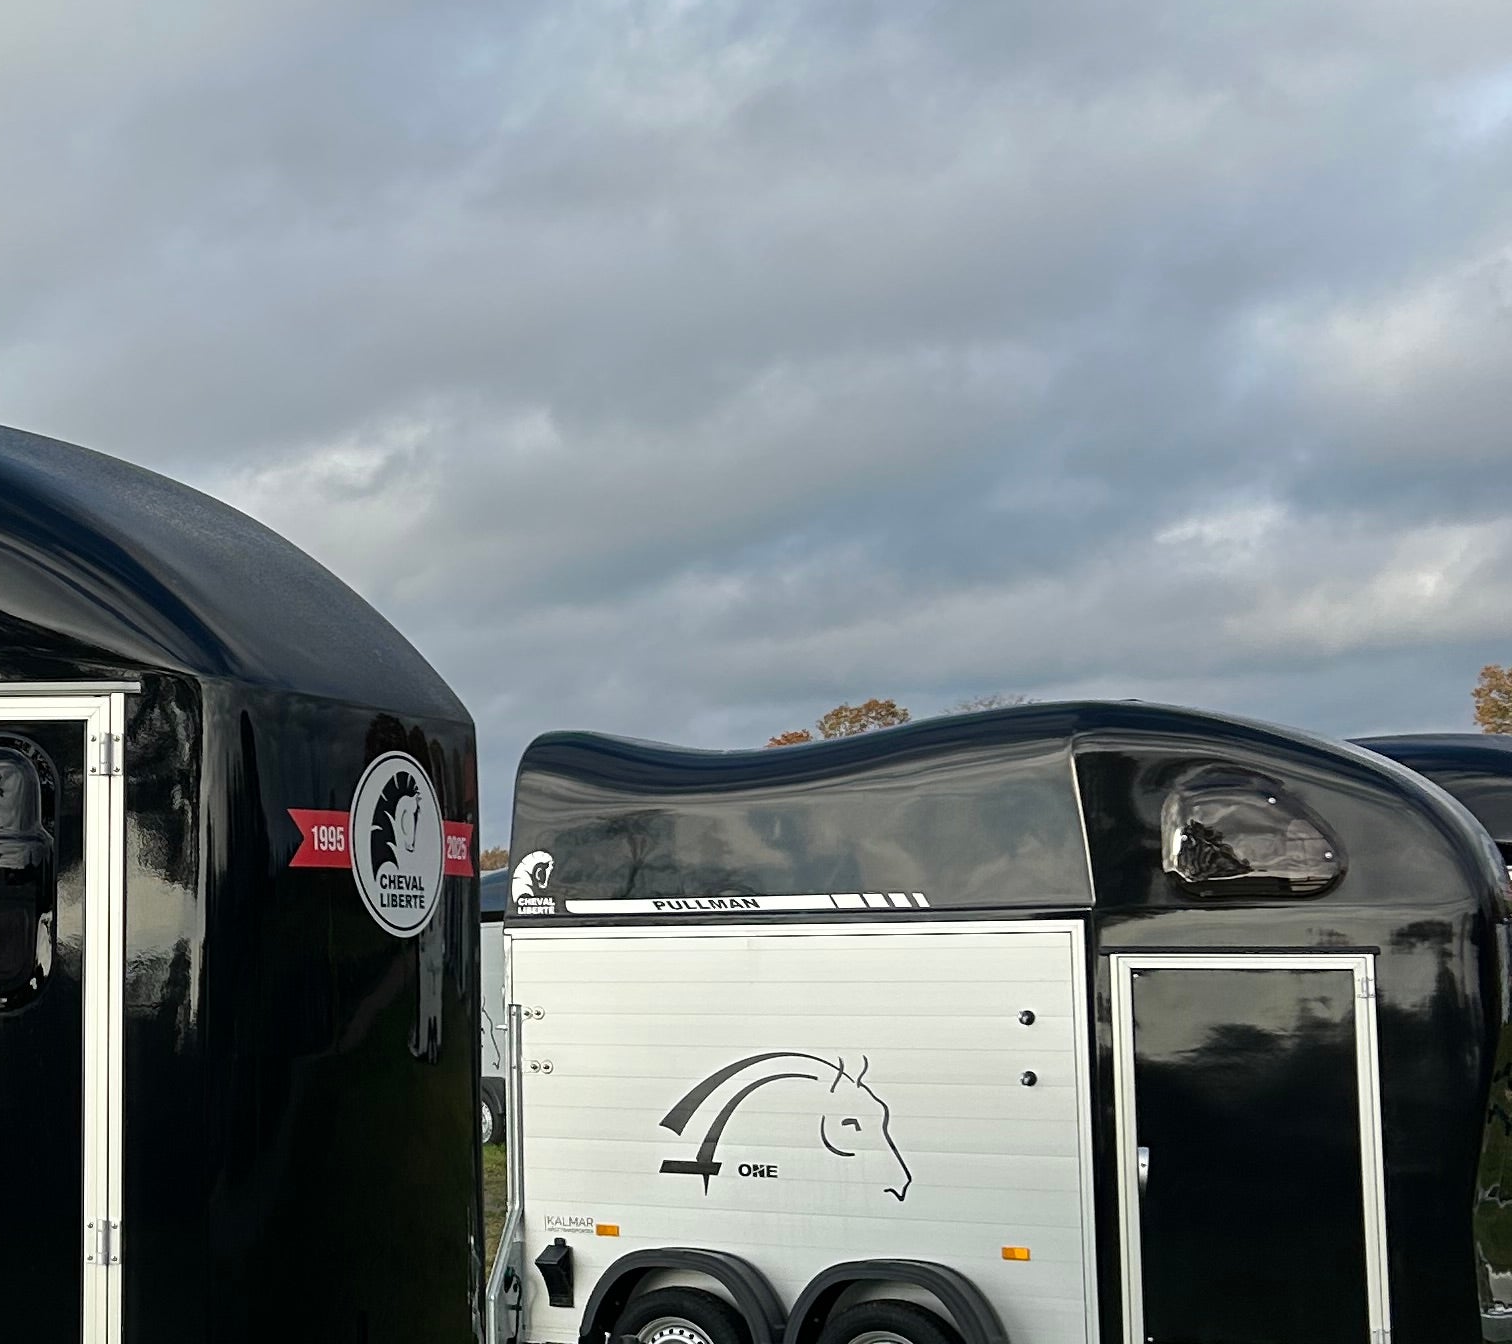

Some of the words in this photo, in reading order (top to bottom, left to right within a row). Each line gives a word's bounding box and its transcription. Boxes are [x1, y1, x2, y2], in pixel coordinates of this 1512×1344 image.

[311, 825, 345, 852] 1995
[447, 835, 467, 860] 2025
[380, 873, 425, 892] CHEVAL
[517, 897, 556, 906] CHEVAL
[652, 898, 761, 911] PULLMAN
[738, 1163, 778, 1179] ONE
[547, 1216, 594, 1228] KALMAR
